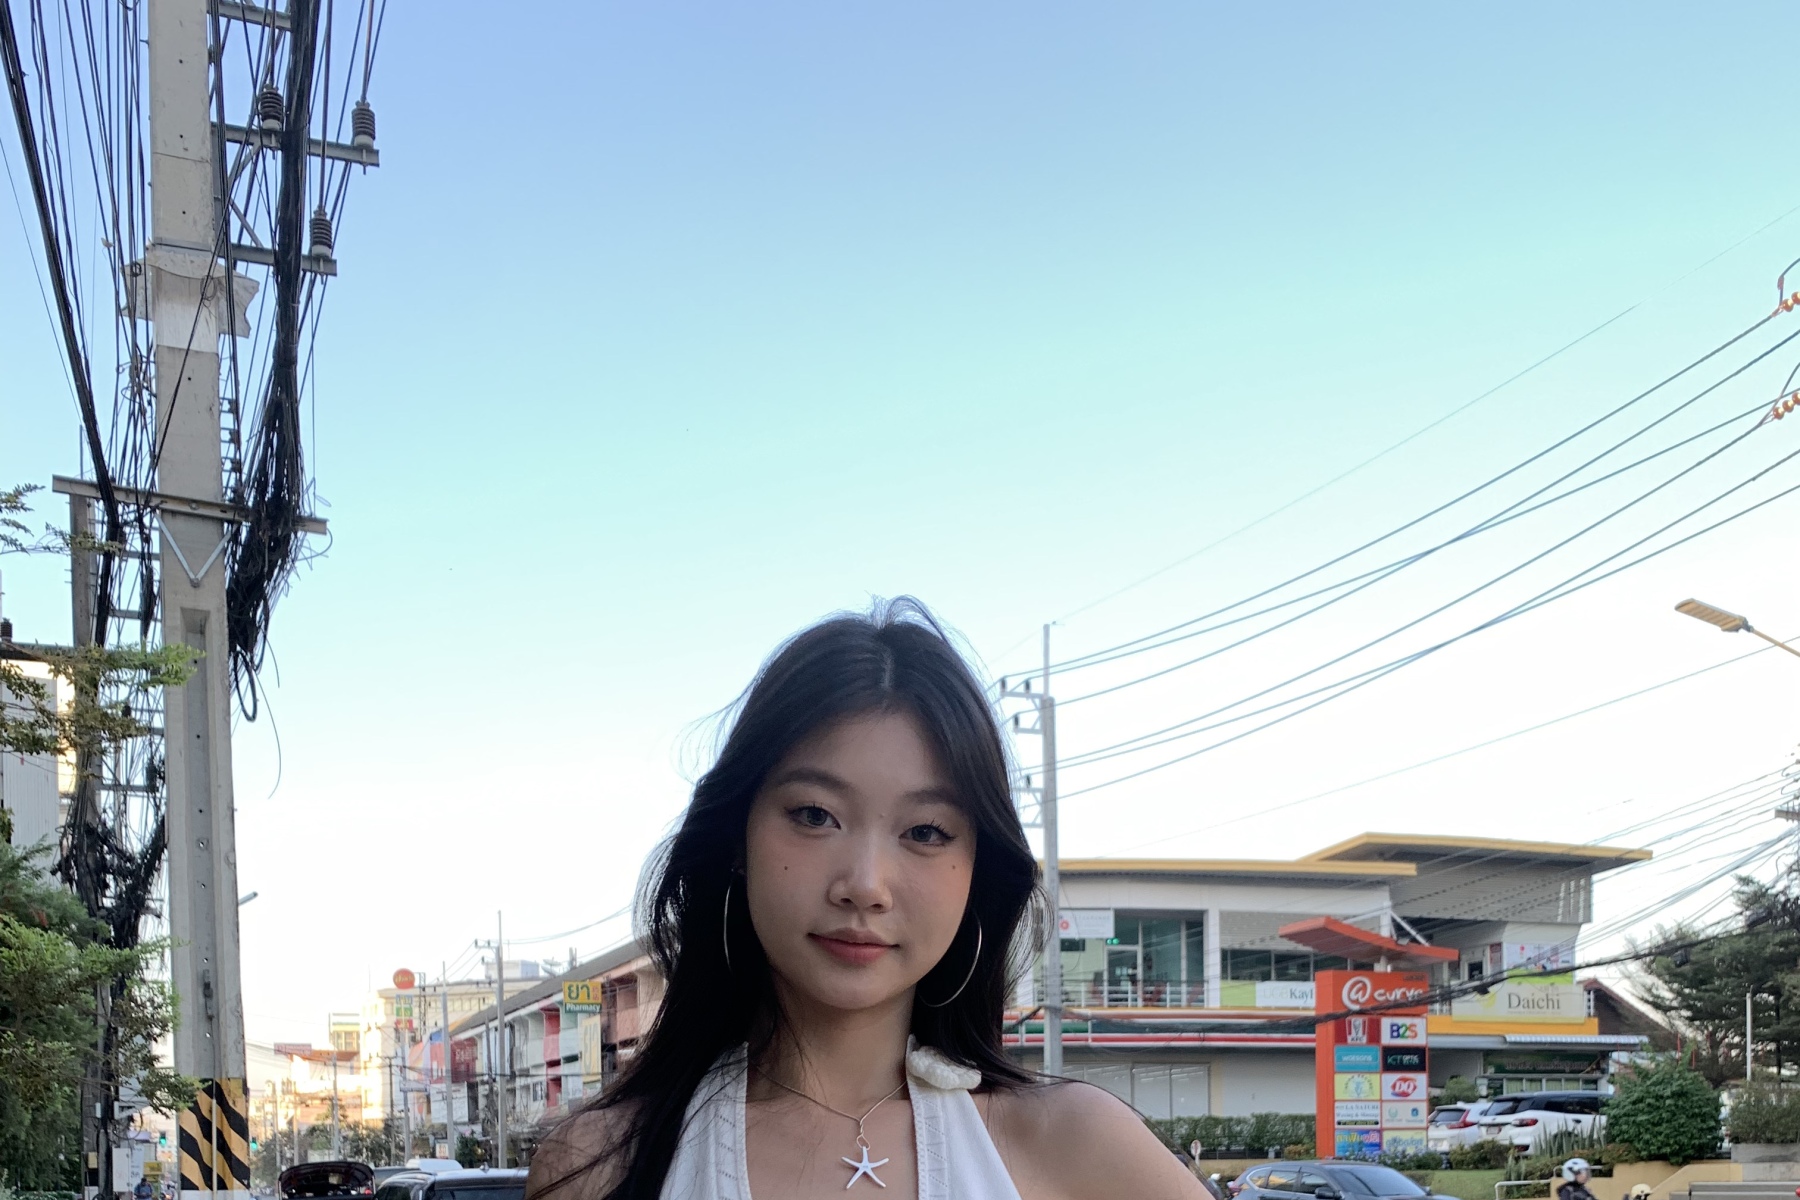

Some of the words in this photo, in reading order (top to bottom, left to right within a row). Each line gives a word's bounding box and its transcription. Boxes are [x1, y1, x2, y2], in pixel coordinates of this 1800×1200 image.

[567, 983, 591, 1000] ยา
[566, 1003, 601, 1013] Pharmacy
[1508, 992, 1561, 1010] Daichi
[1389, 1023, 1418, 1039] B2S
[1394, 1081, 1415, 1094] DQ
